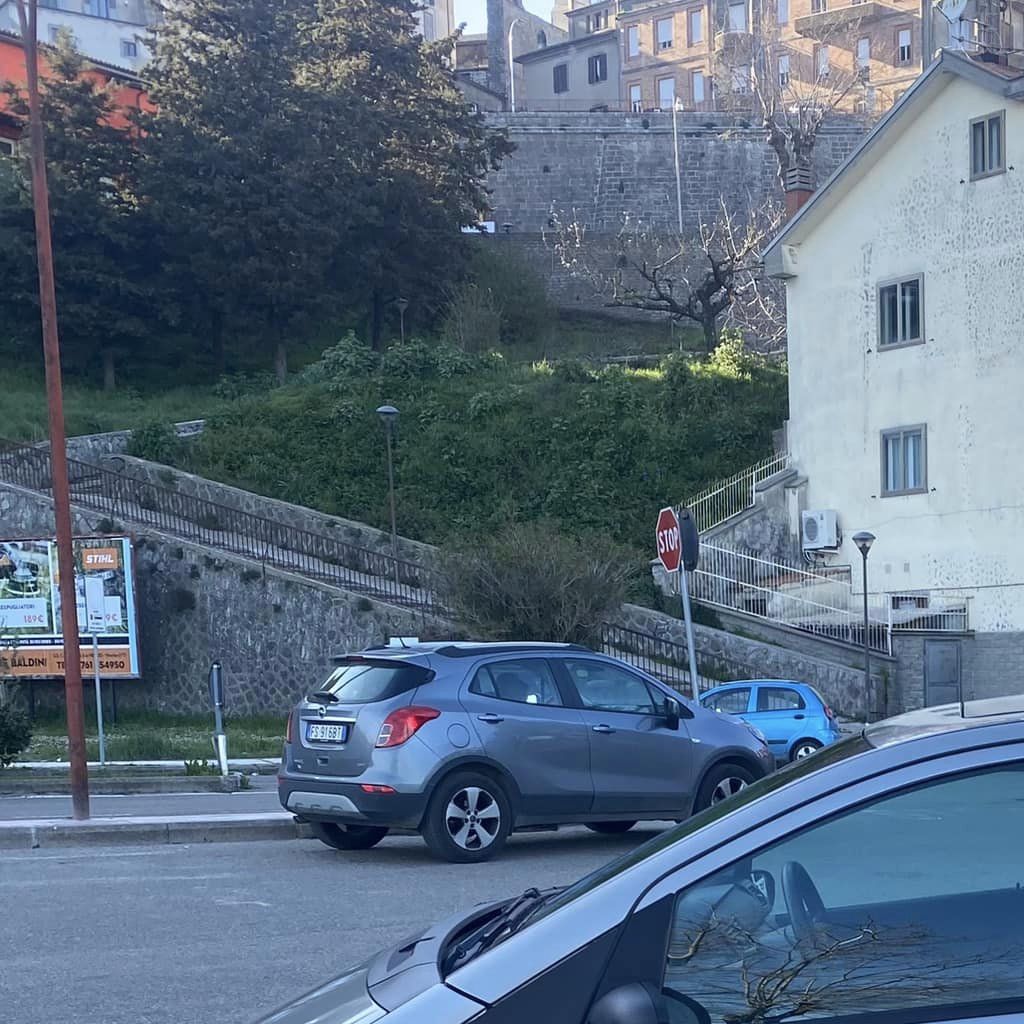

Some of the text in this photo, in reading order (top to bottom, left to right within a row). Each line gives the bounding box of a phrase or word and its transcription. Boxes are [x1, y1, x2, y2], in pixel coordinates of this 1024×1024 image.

[658, 526, 679, 553] STOP
[86, 554, 114, 563] STIHL
[11, 657, 48, 668] BALDINI
